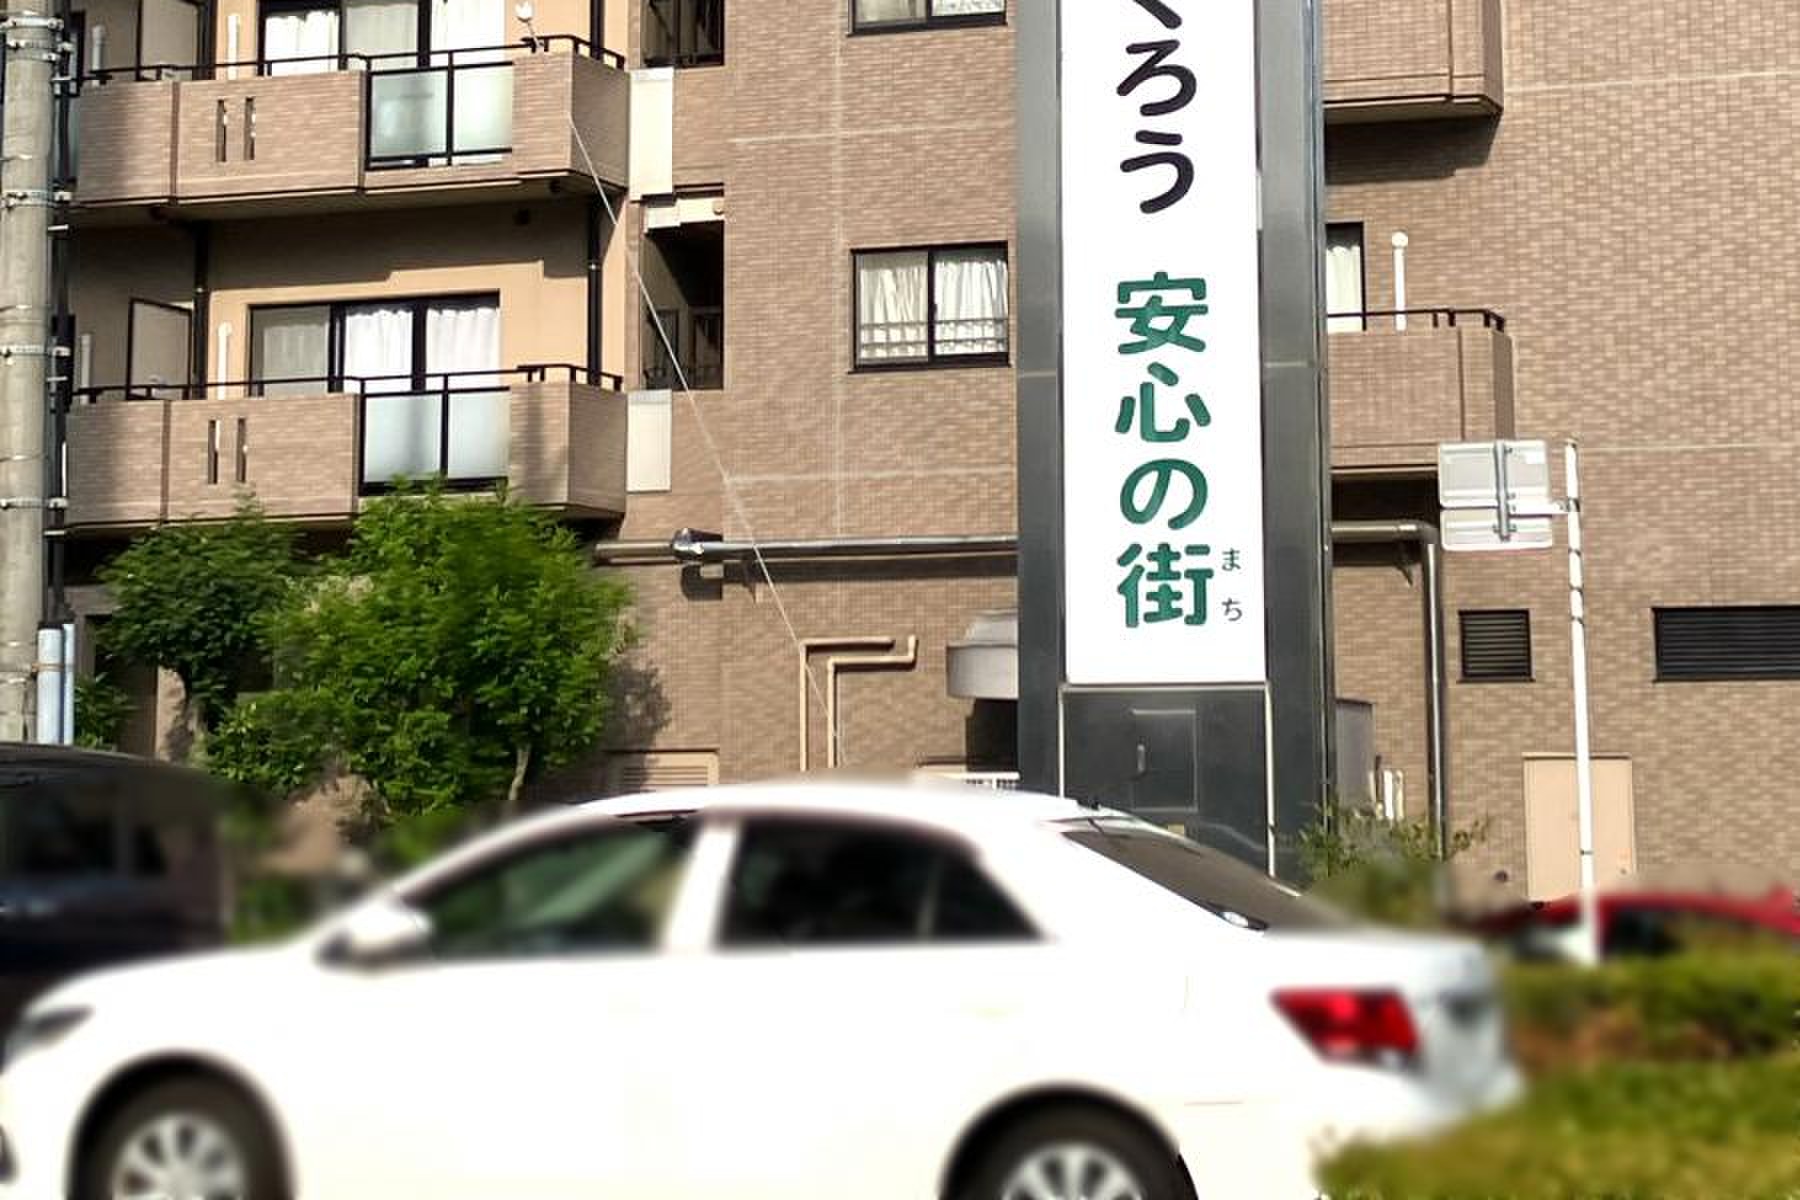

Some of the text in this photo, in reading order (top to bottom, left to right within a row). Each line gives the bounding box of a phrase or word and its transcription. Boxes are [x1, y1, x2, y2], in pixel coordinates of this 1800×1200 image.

[1115, 271, 1214, 628] 安心の街
[1221, 547, 1243, 622] まち
